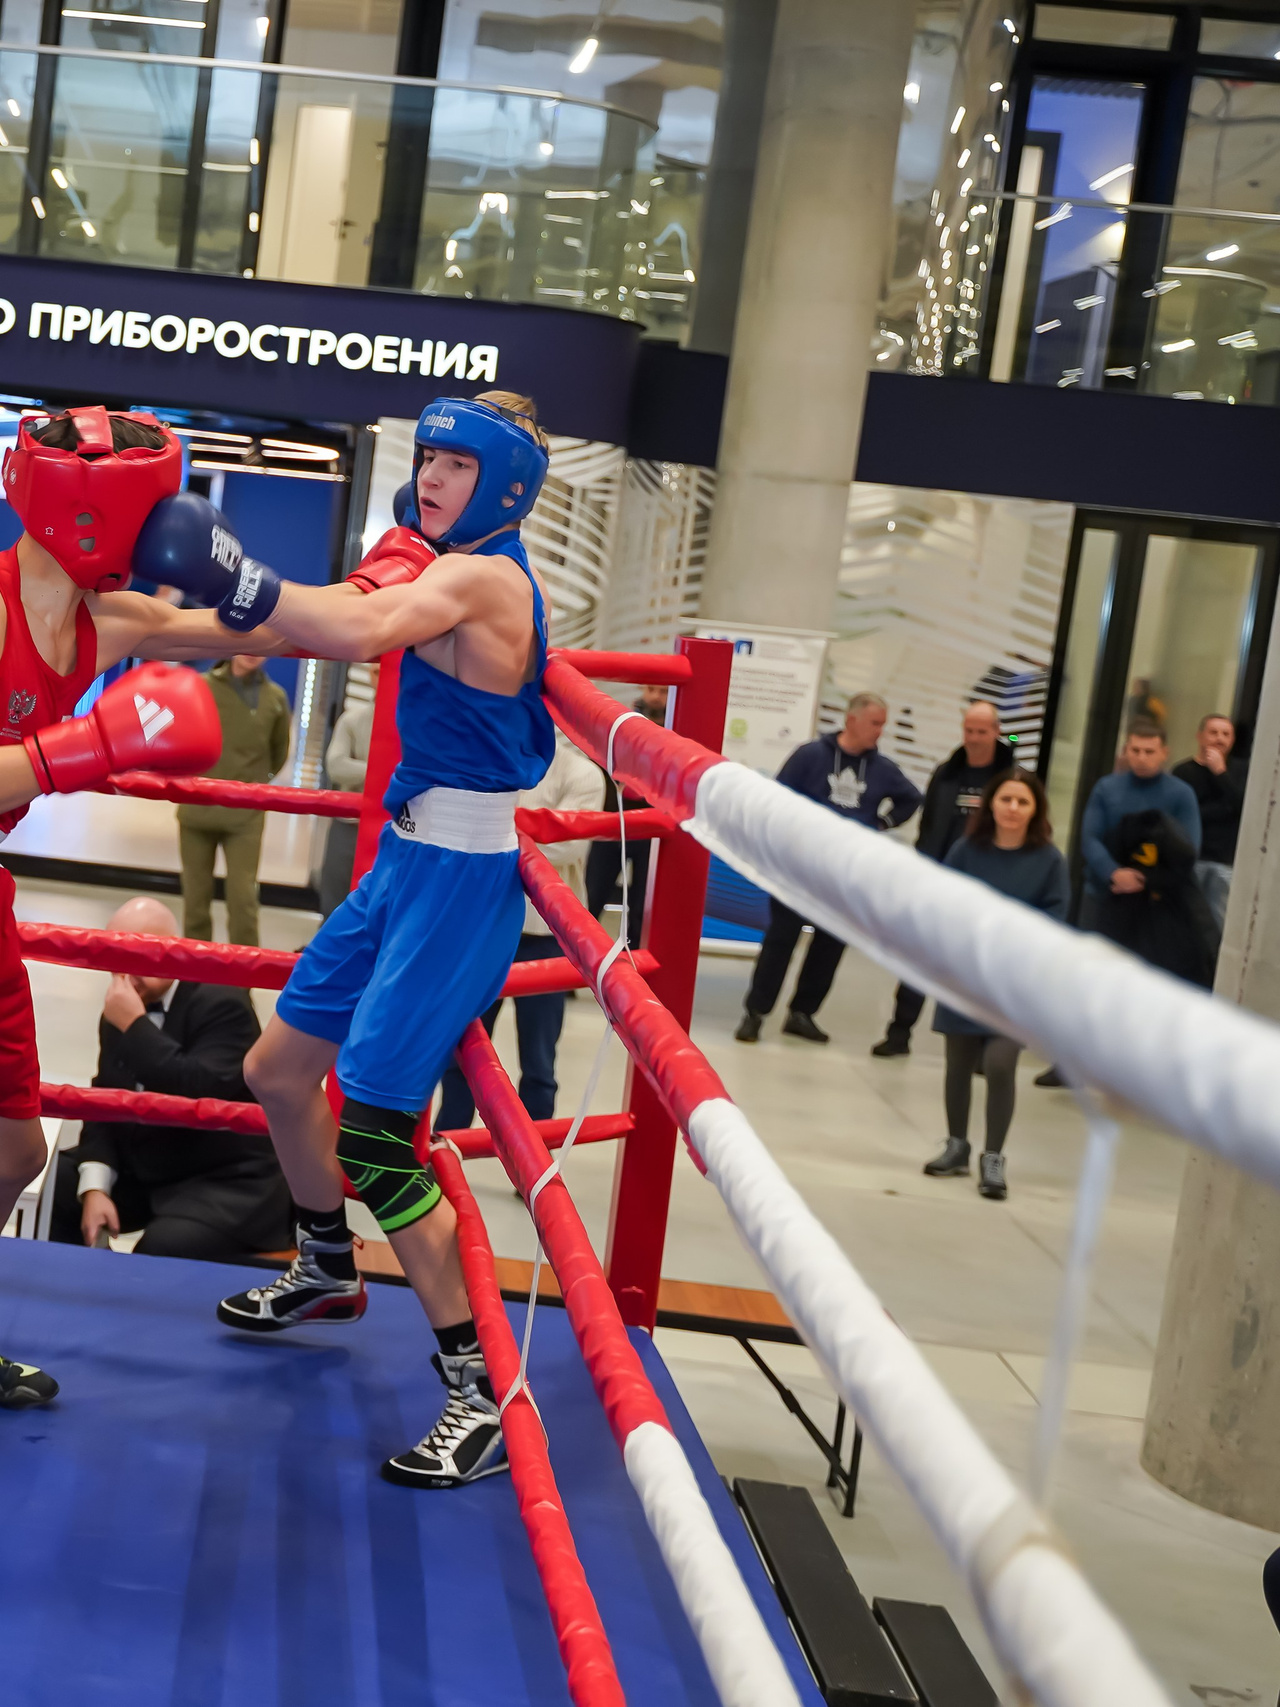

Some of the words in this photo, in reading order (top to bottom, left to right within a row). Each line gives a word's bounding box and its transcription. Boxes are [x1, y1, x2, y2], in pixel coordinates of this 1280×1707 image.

[28, 302, 500, 383] ПРИБОРОСТРОЕНИЯ
[423, 412, 456, 431] clinch
[232, 557, 255, 606] GREEN
[240, 565, 263, 609] HILL
